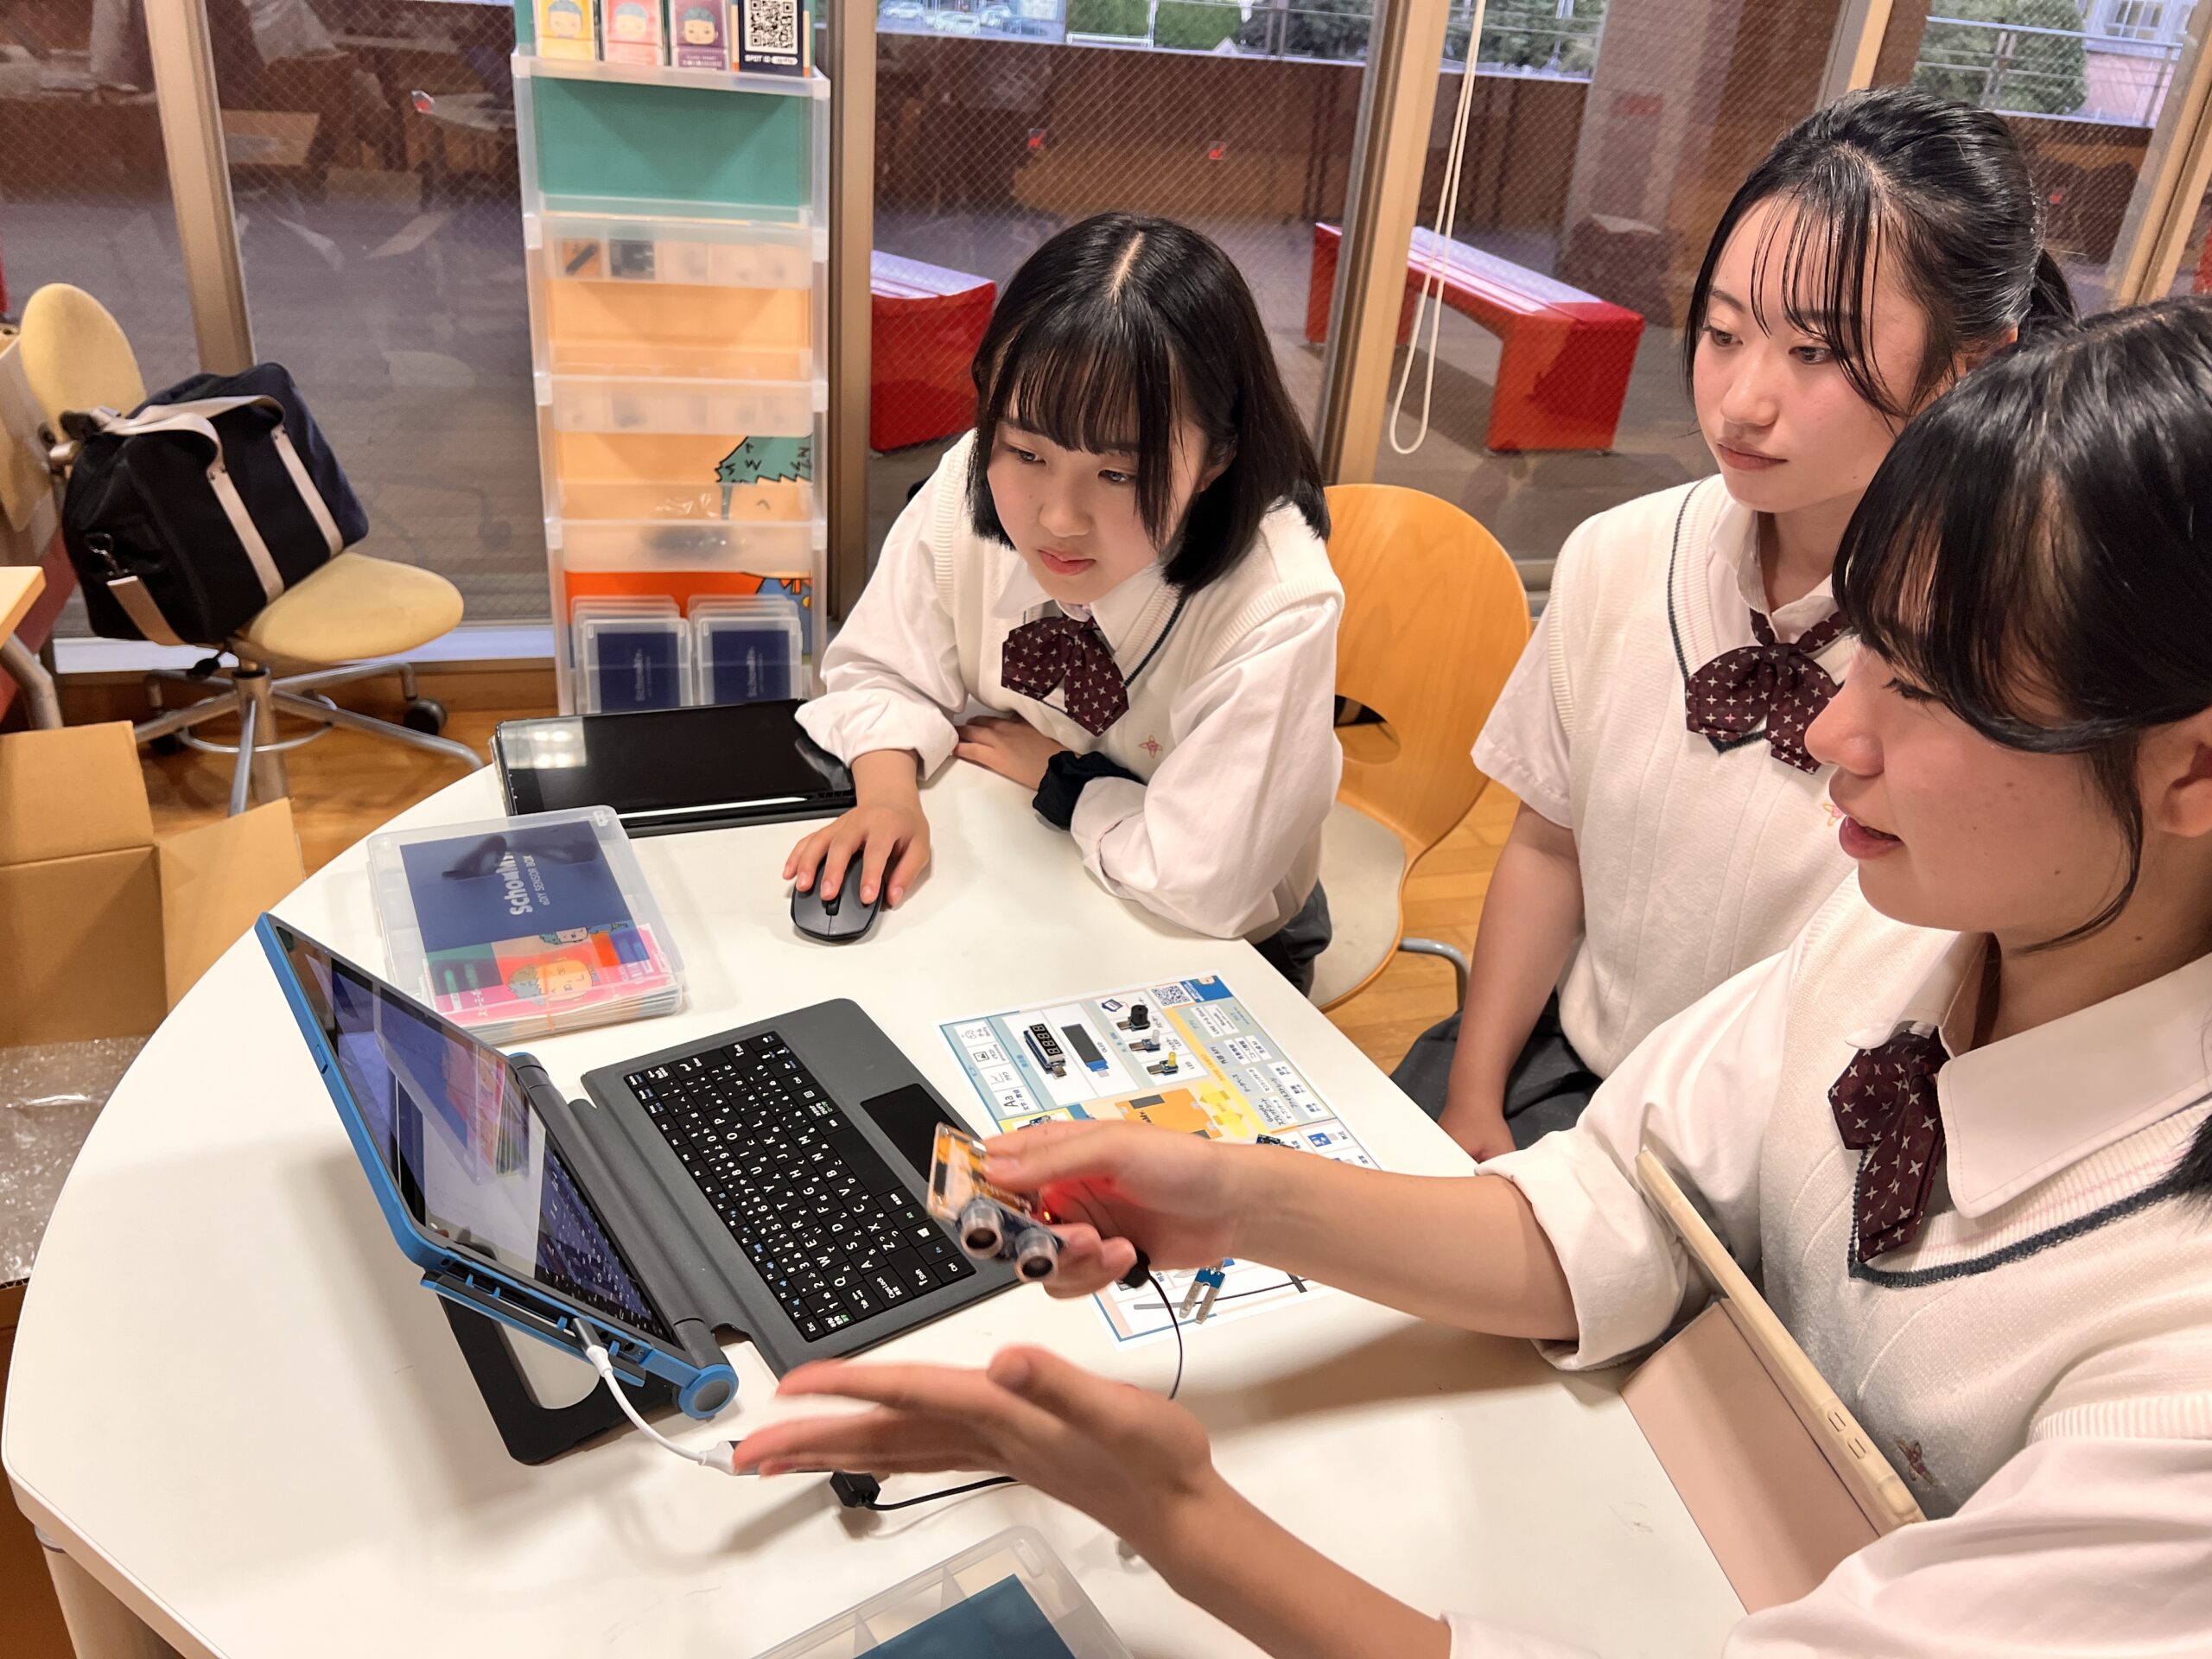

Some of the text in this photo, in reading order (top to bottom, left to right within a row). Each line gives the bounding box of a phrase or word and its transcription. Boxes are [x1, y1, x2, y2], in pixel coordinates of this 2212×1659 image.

[1003, 1095, 1018, 1107] Aa
[763, 1135, 775, 1144] K
[798, 1135, 810, 1144] M
[750, 1166, 761, 1174] U
[789, 1169, 801, 1178] H
[853, 1204, 864, 1212] C
[791, 1220, 803, 1229] R
[831, 1223, 843, 1231] D
[868, 1222, 880, 1231] X
[804, 1238, 817, 1248] E
[846, 1241, 857, 1249] S
[882, 1241, 895, 1250] Z
[816, 1255, 830, 1267] W
[915, 1268, 926, 1280] Shift
[834, 1275, 846, 1287] Q
[876, 1276, 895, 1298] Caps Lock
